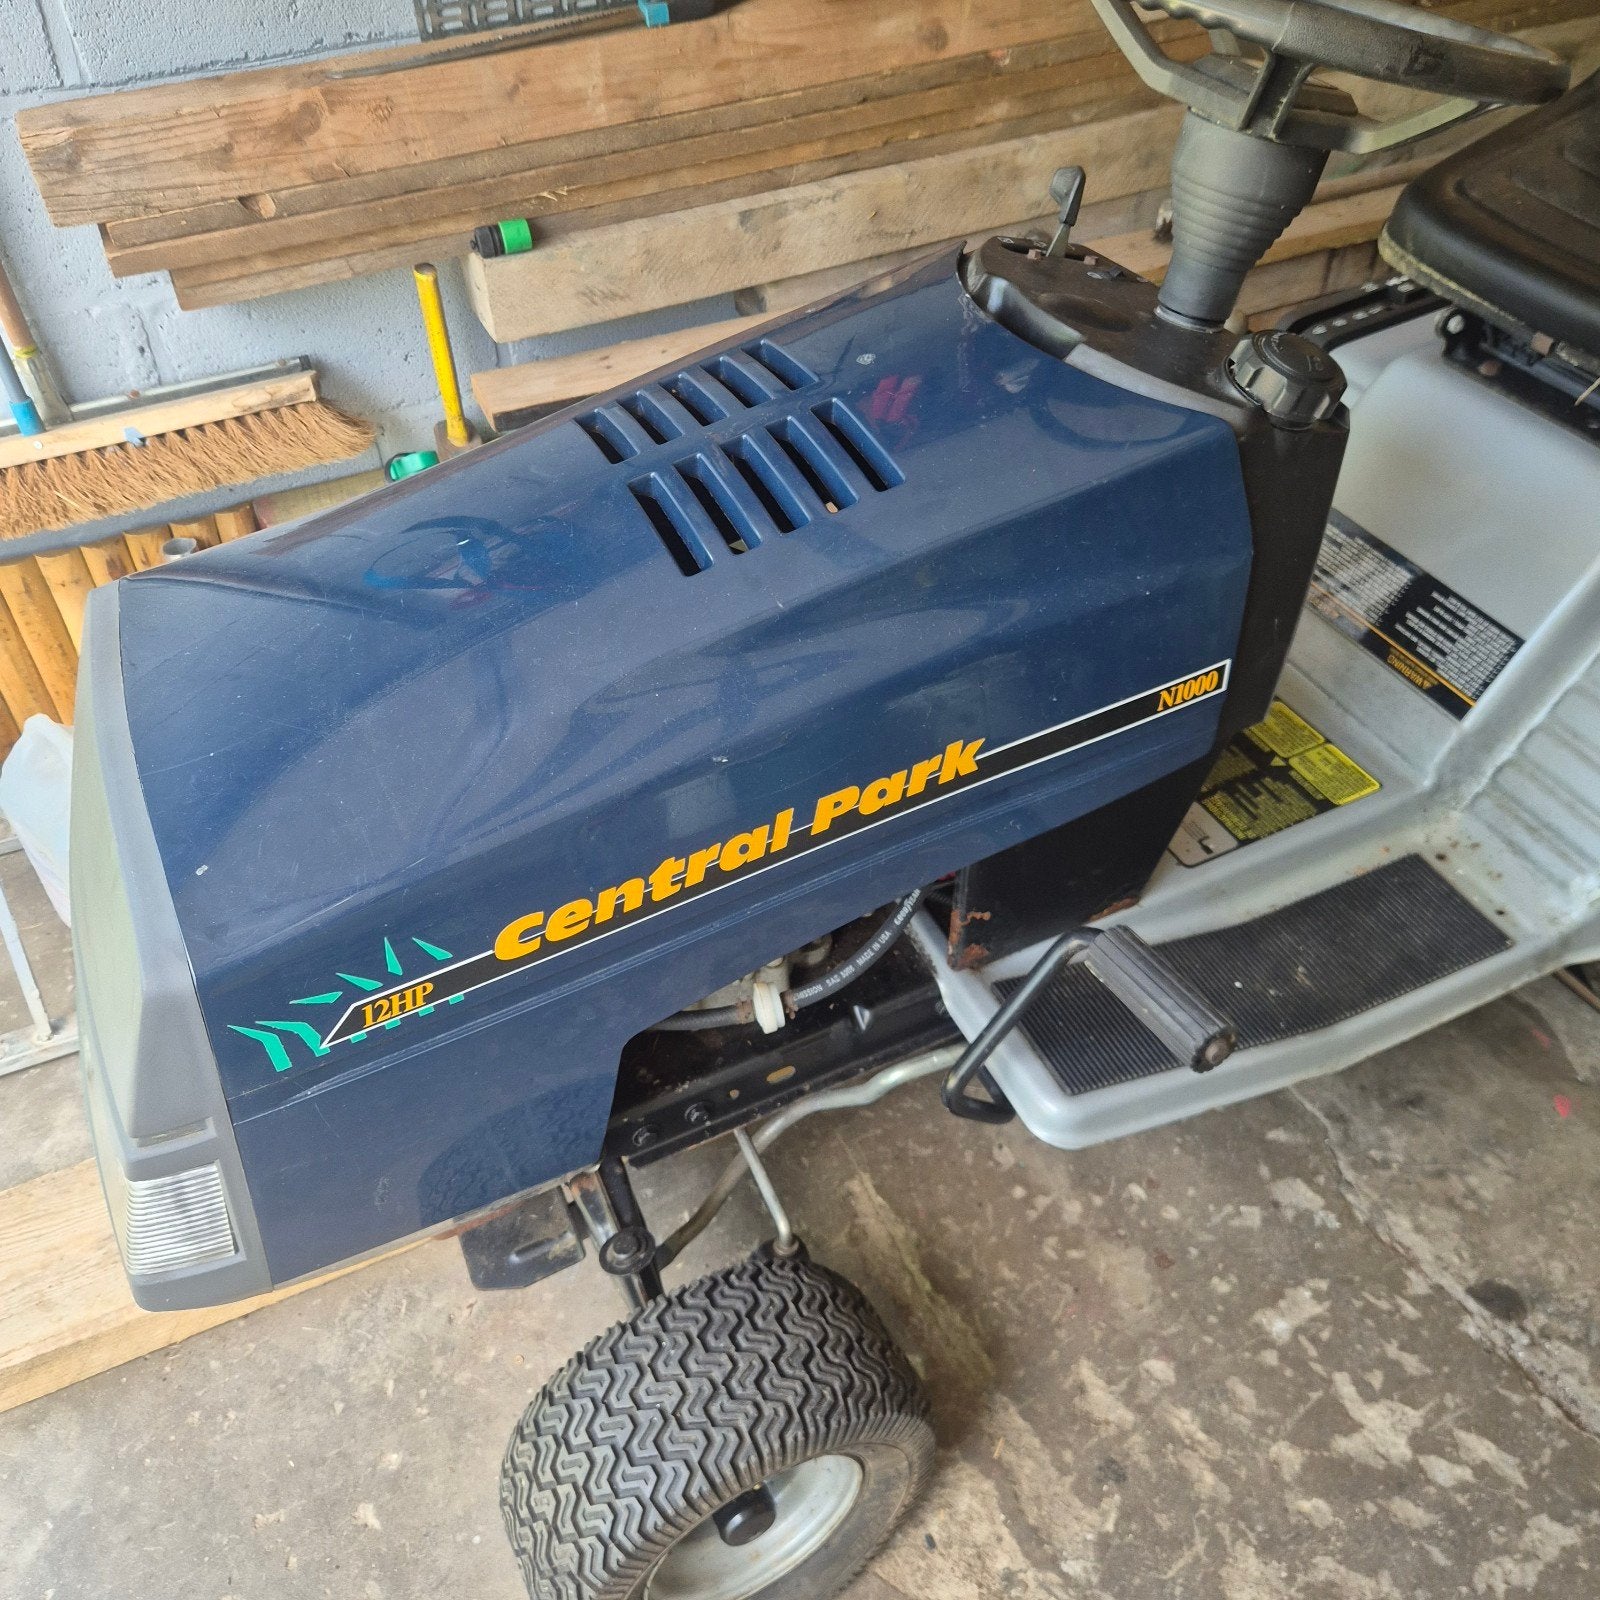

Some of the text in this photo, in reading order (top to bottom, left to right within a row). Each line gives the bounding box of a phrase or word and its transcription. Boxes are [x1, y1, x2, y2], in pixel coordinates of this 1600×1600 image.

[1157, 670, 1219, 711] N1000
[810, 737, 986, 836] Park
[856, 948, 875, 966] MADE
[872, 941, 881, 952] IN
[878, 930, 892, 944] USA
[894, 888, 921, 926] GOODYEAR
[361, 982, 434, 1029] 12HP
